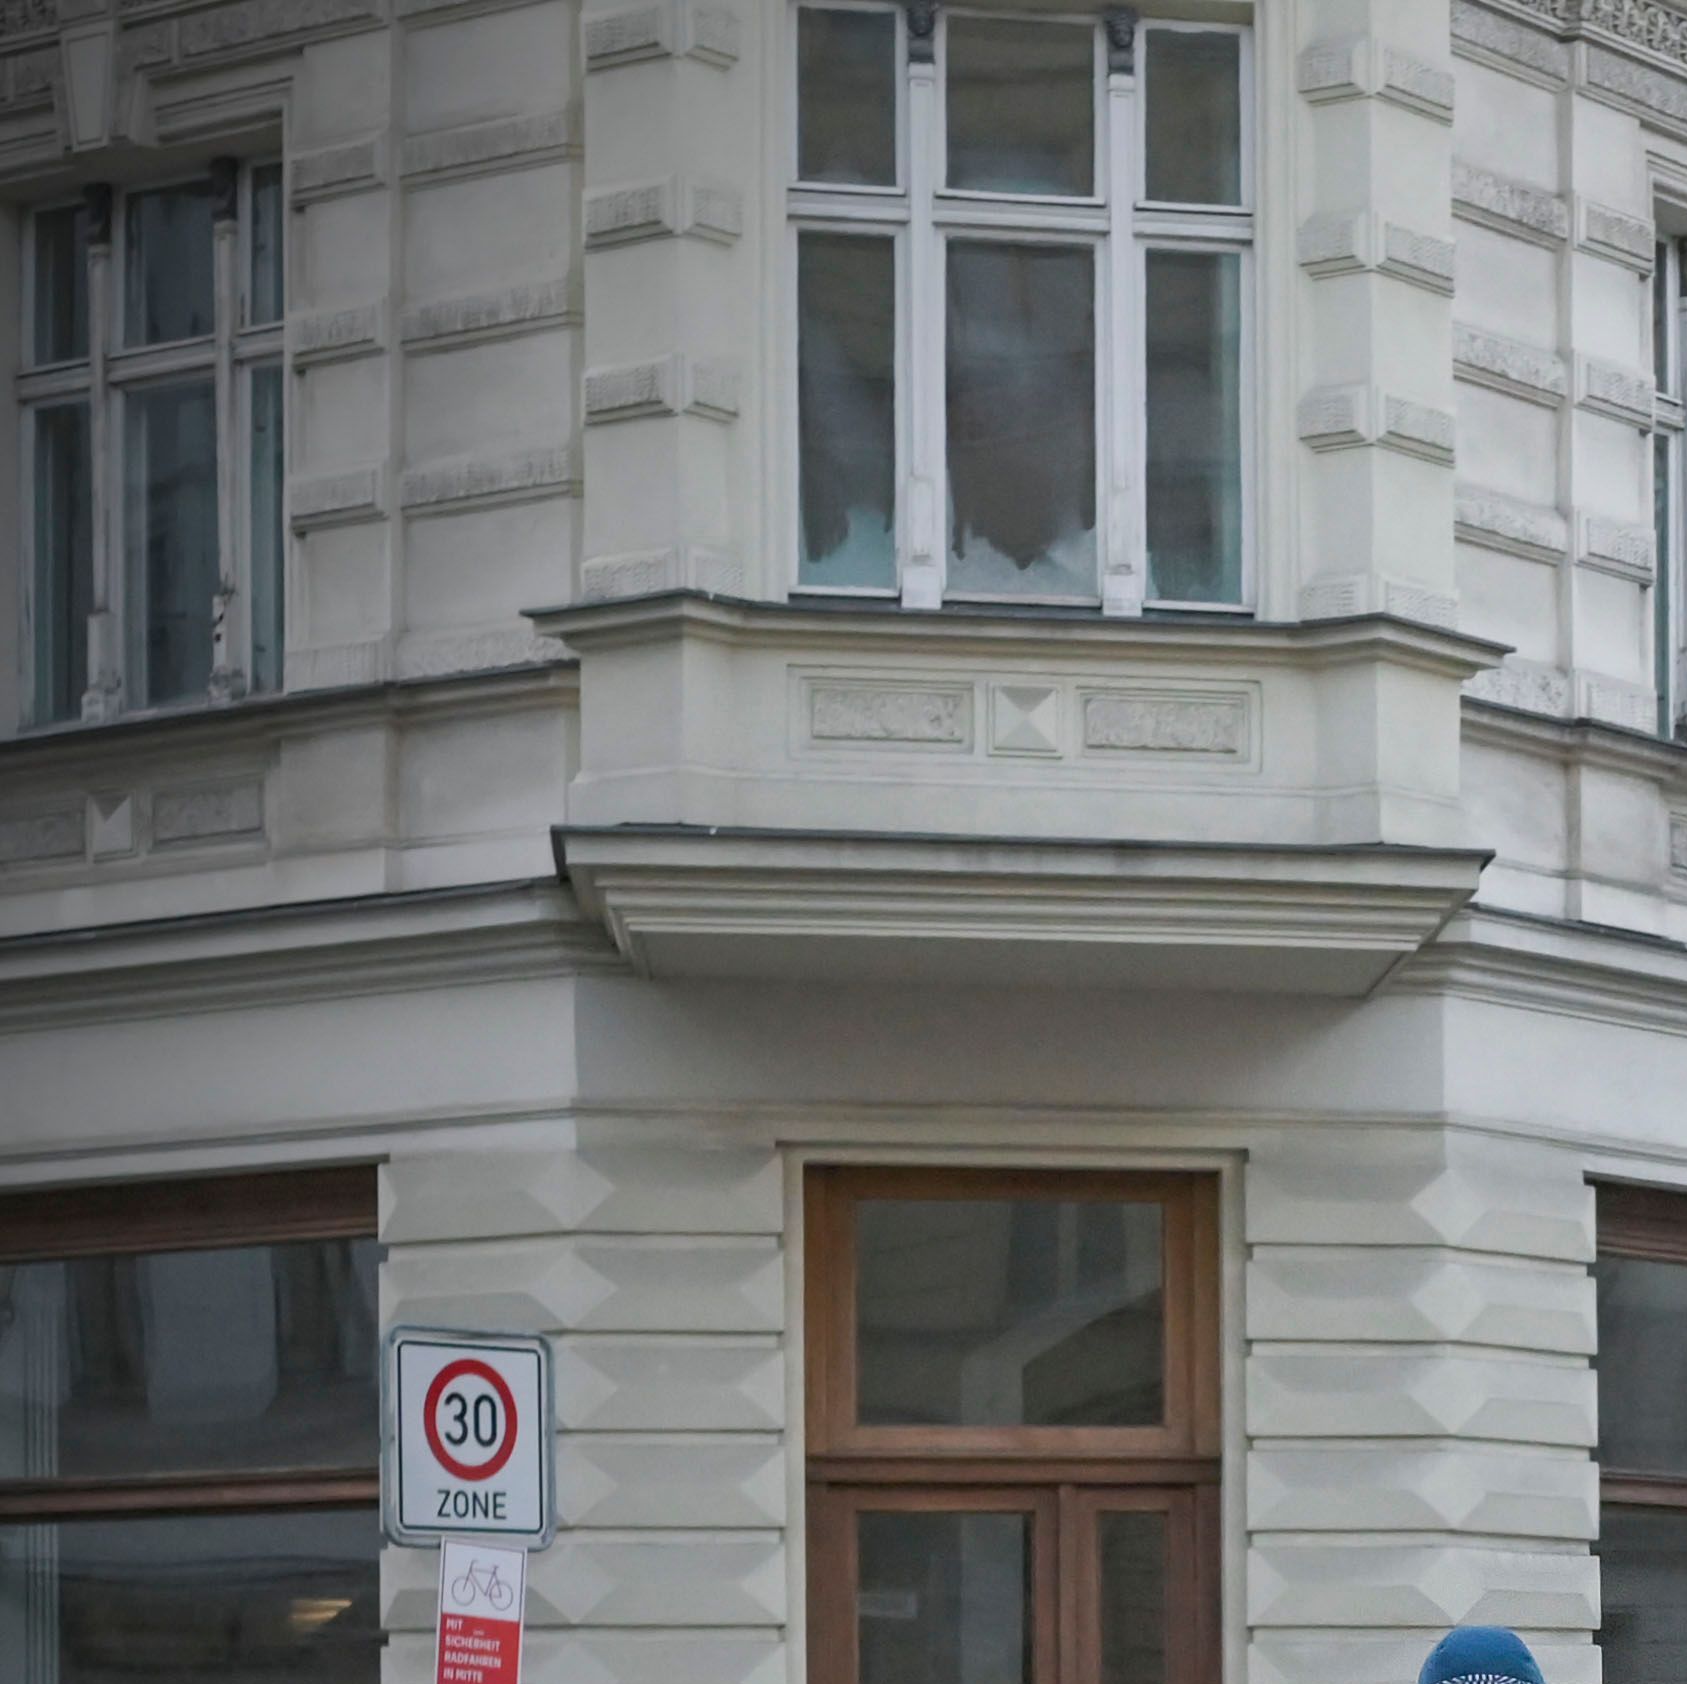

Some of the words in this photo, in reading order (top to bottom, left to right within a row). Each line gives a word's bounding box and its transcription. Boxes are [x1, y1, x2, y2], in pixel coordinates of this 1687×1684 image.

[443, 1391, 498, 1448] 30
[436, 1488, 508, 1521] ZONE
[446, 1618, 463, 1631] MIT
[444, 1634, 500, 1652] SICHERHEIT
[444, 1650, 502, 1668] RADFAHREN
[443, 1667, 453, 1680] IN
[455, 1669, 483, 1684] MITTE
